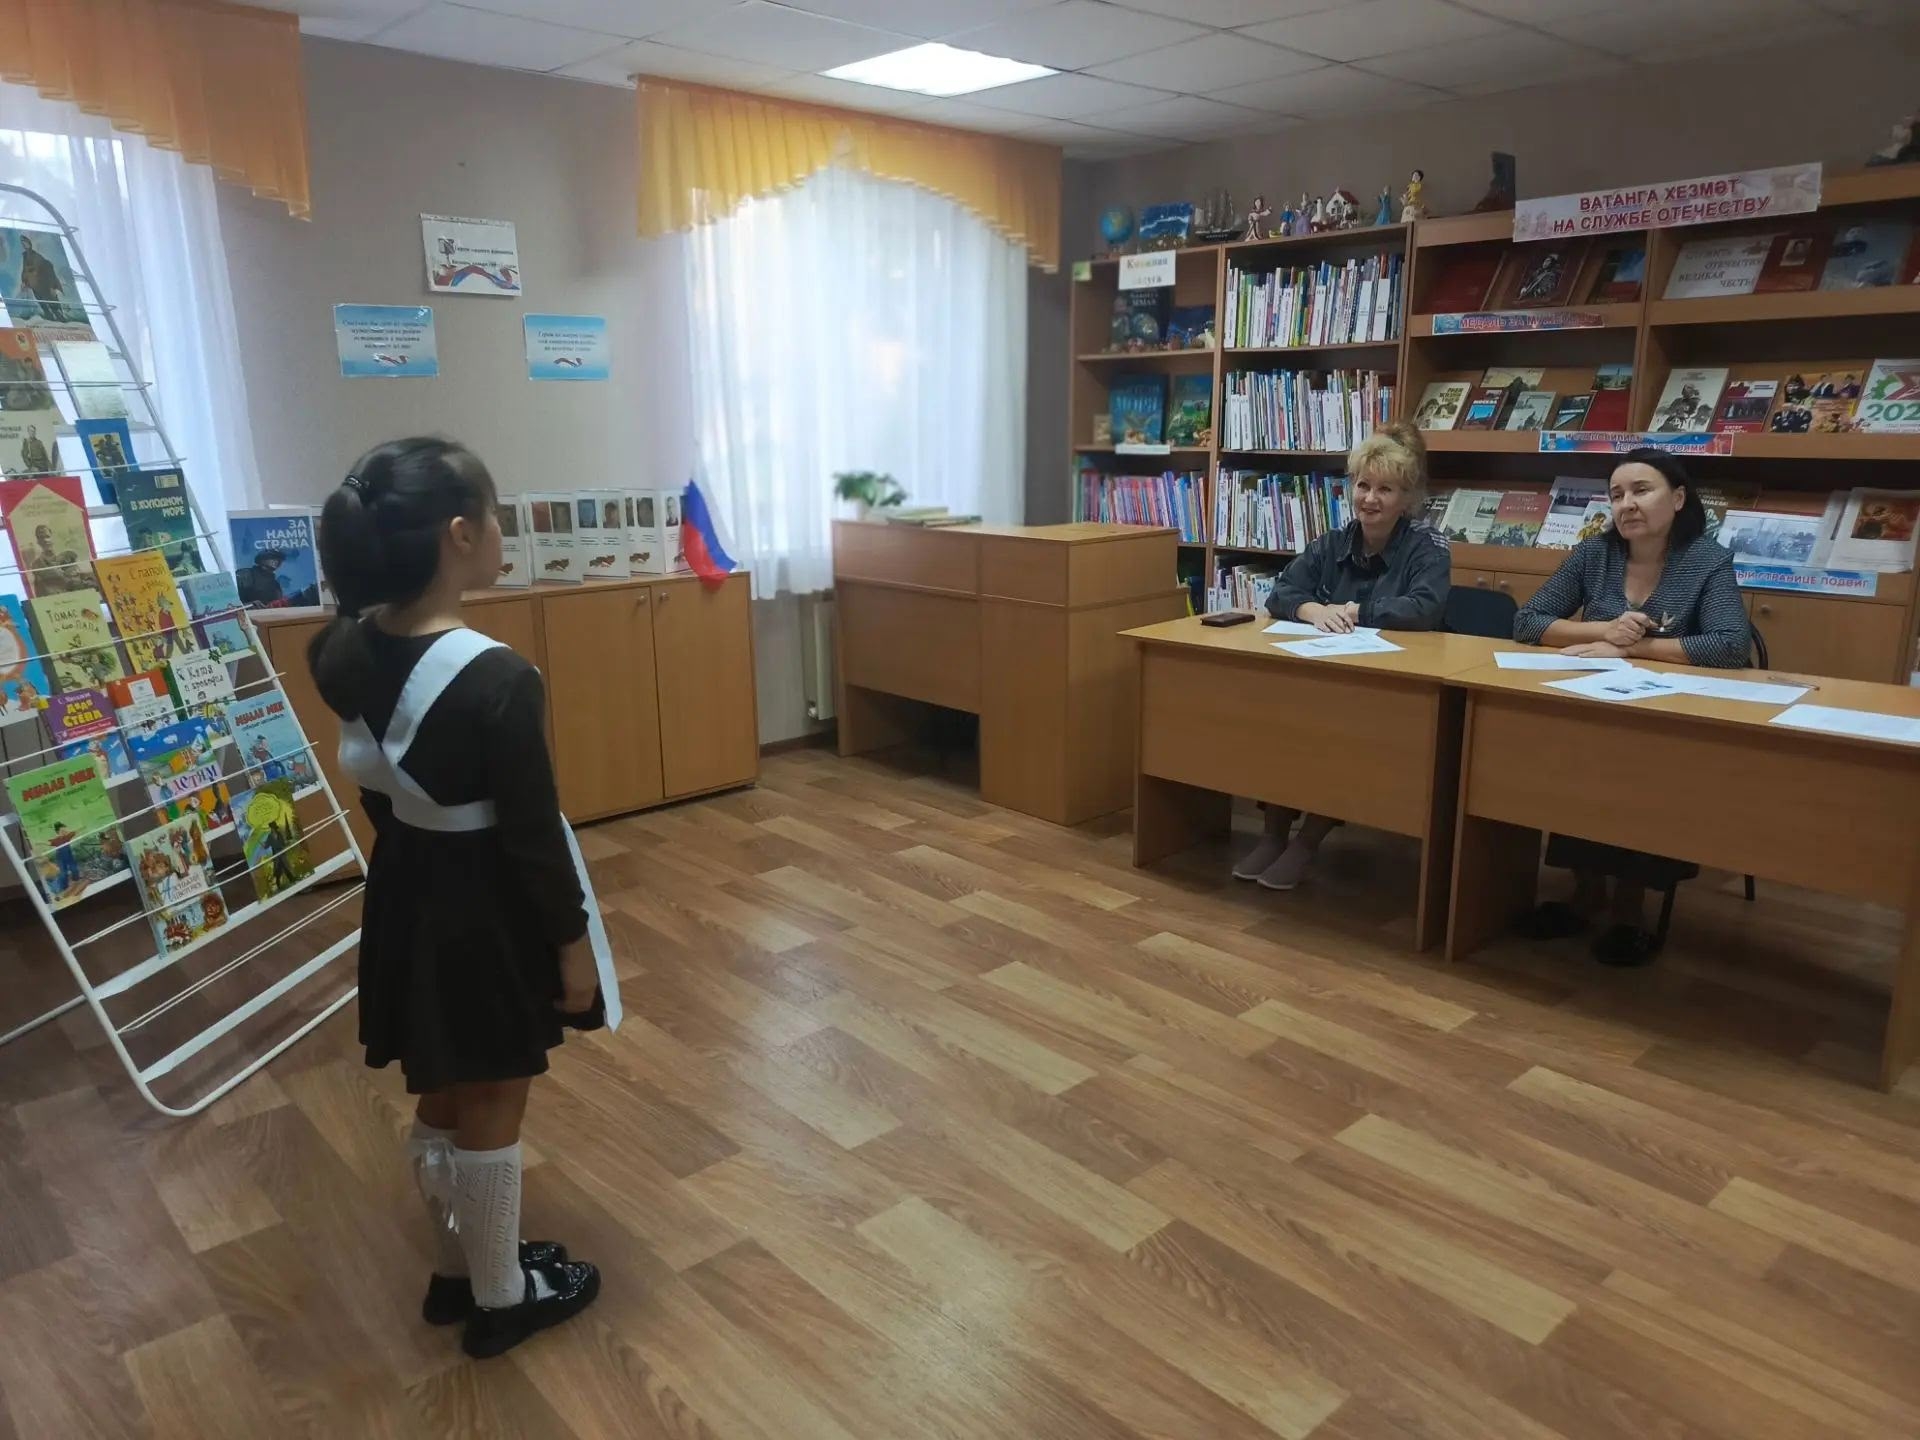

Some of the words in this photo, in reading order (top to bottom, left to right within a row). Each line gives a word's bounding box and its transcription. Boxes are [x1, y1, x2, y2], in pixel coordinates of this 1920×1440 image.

[1579, 189, 1658, 213] ВАТАНГА
[1665, 177, 1740, 199] ХЕЗМӘТ
[1553, 218, 1575, 233] НА
[1580, 210, 1651, 230] СЛУЖБЕ
[1656, 195, 1771, 222] ОТЕЧЕСТВУ
[130, 500, 138, 511] В
[138, 496, 184, 510] ХОЛОДНОМ
[162, 505, 185, 518] МОРЕ
[287, 519, 307, 529] ЗА
[265, 529, 308, 540] НАМИ
[254, 538, 310, 550] СТРАНА
